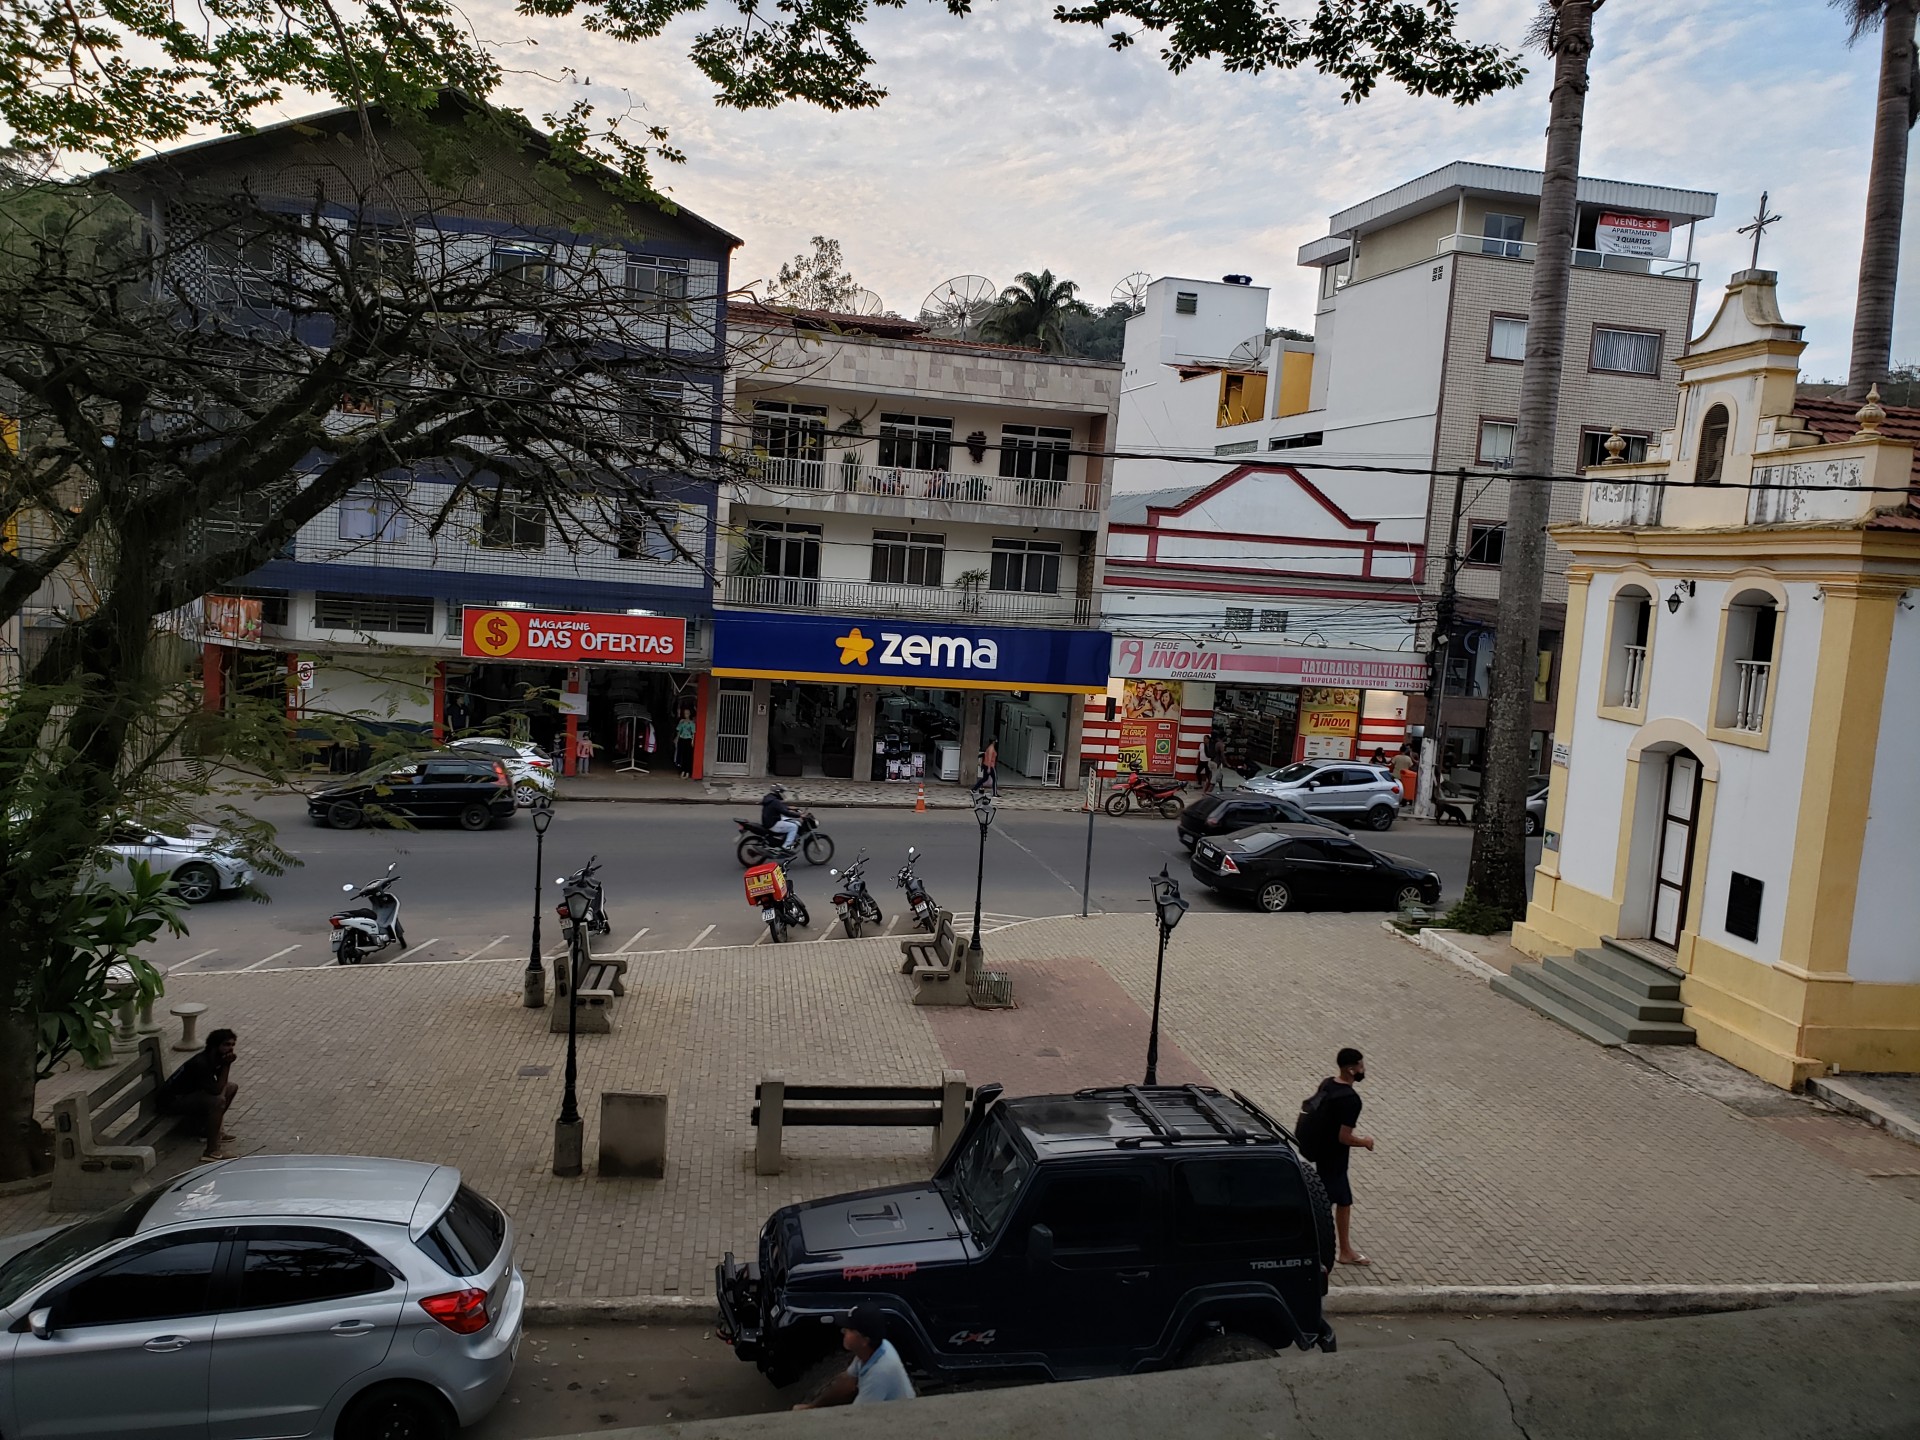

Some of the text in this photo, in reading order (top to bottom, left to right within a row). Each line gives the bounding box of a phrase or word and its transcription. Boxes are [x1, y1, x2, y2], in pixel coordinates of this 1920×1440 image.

[1614, 218, 1657, 228] VENDE-SE
[1612, 227, 1657, 237] APARTAMENTO
[1621, 236, 1651, 245] QUARTOS
[528, 618, 591, 631] MAGAZINE
[528, 629, 674, 654] DAS OFERTAS
[1153, 641, 1180, 650] REDE
[880, 632, 998, 669] zema
[1147, 650, 1218, 670] INOVA
[1301, 660, 1360, 675] NATURALIS
[1170, 671, 1217, 679] DROGARIAS
[1301, 676, 1346, 685] MANIPULAÇÃO
[1352, 679, 1388, 687] DRUGSTORE
[1320, 718, 1350, 727] INOVA
[1249, 1259, 1302, 1270] TROLLER
